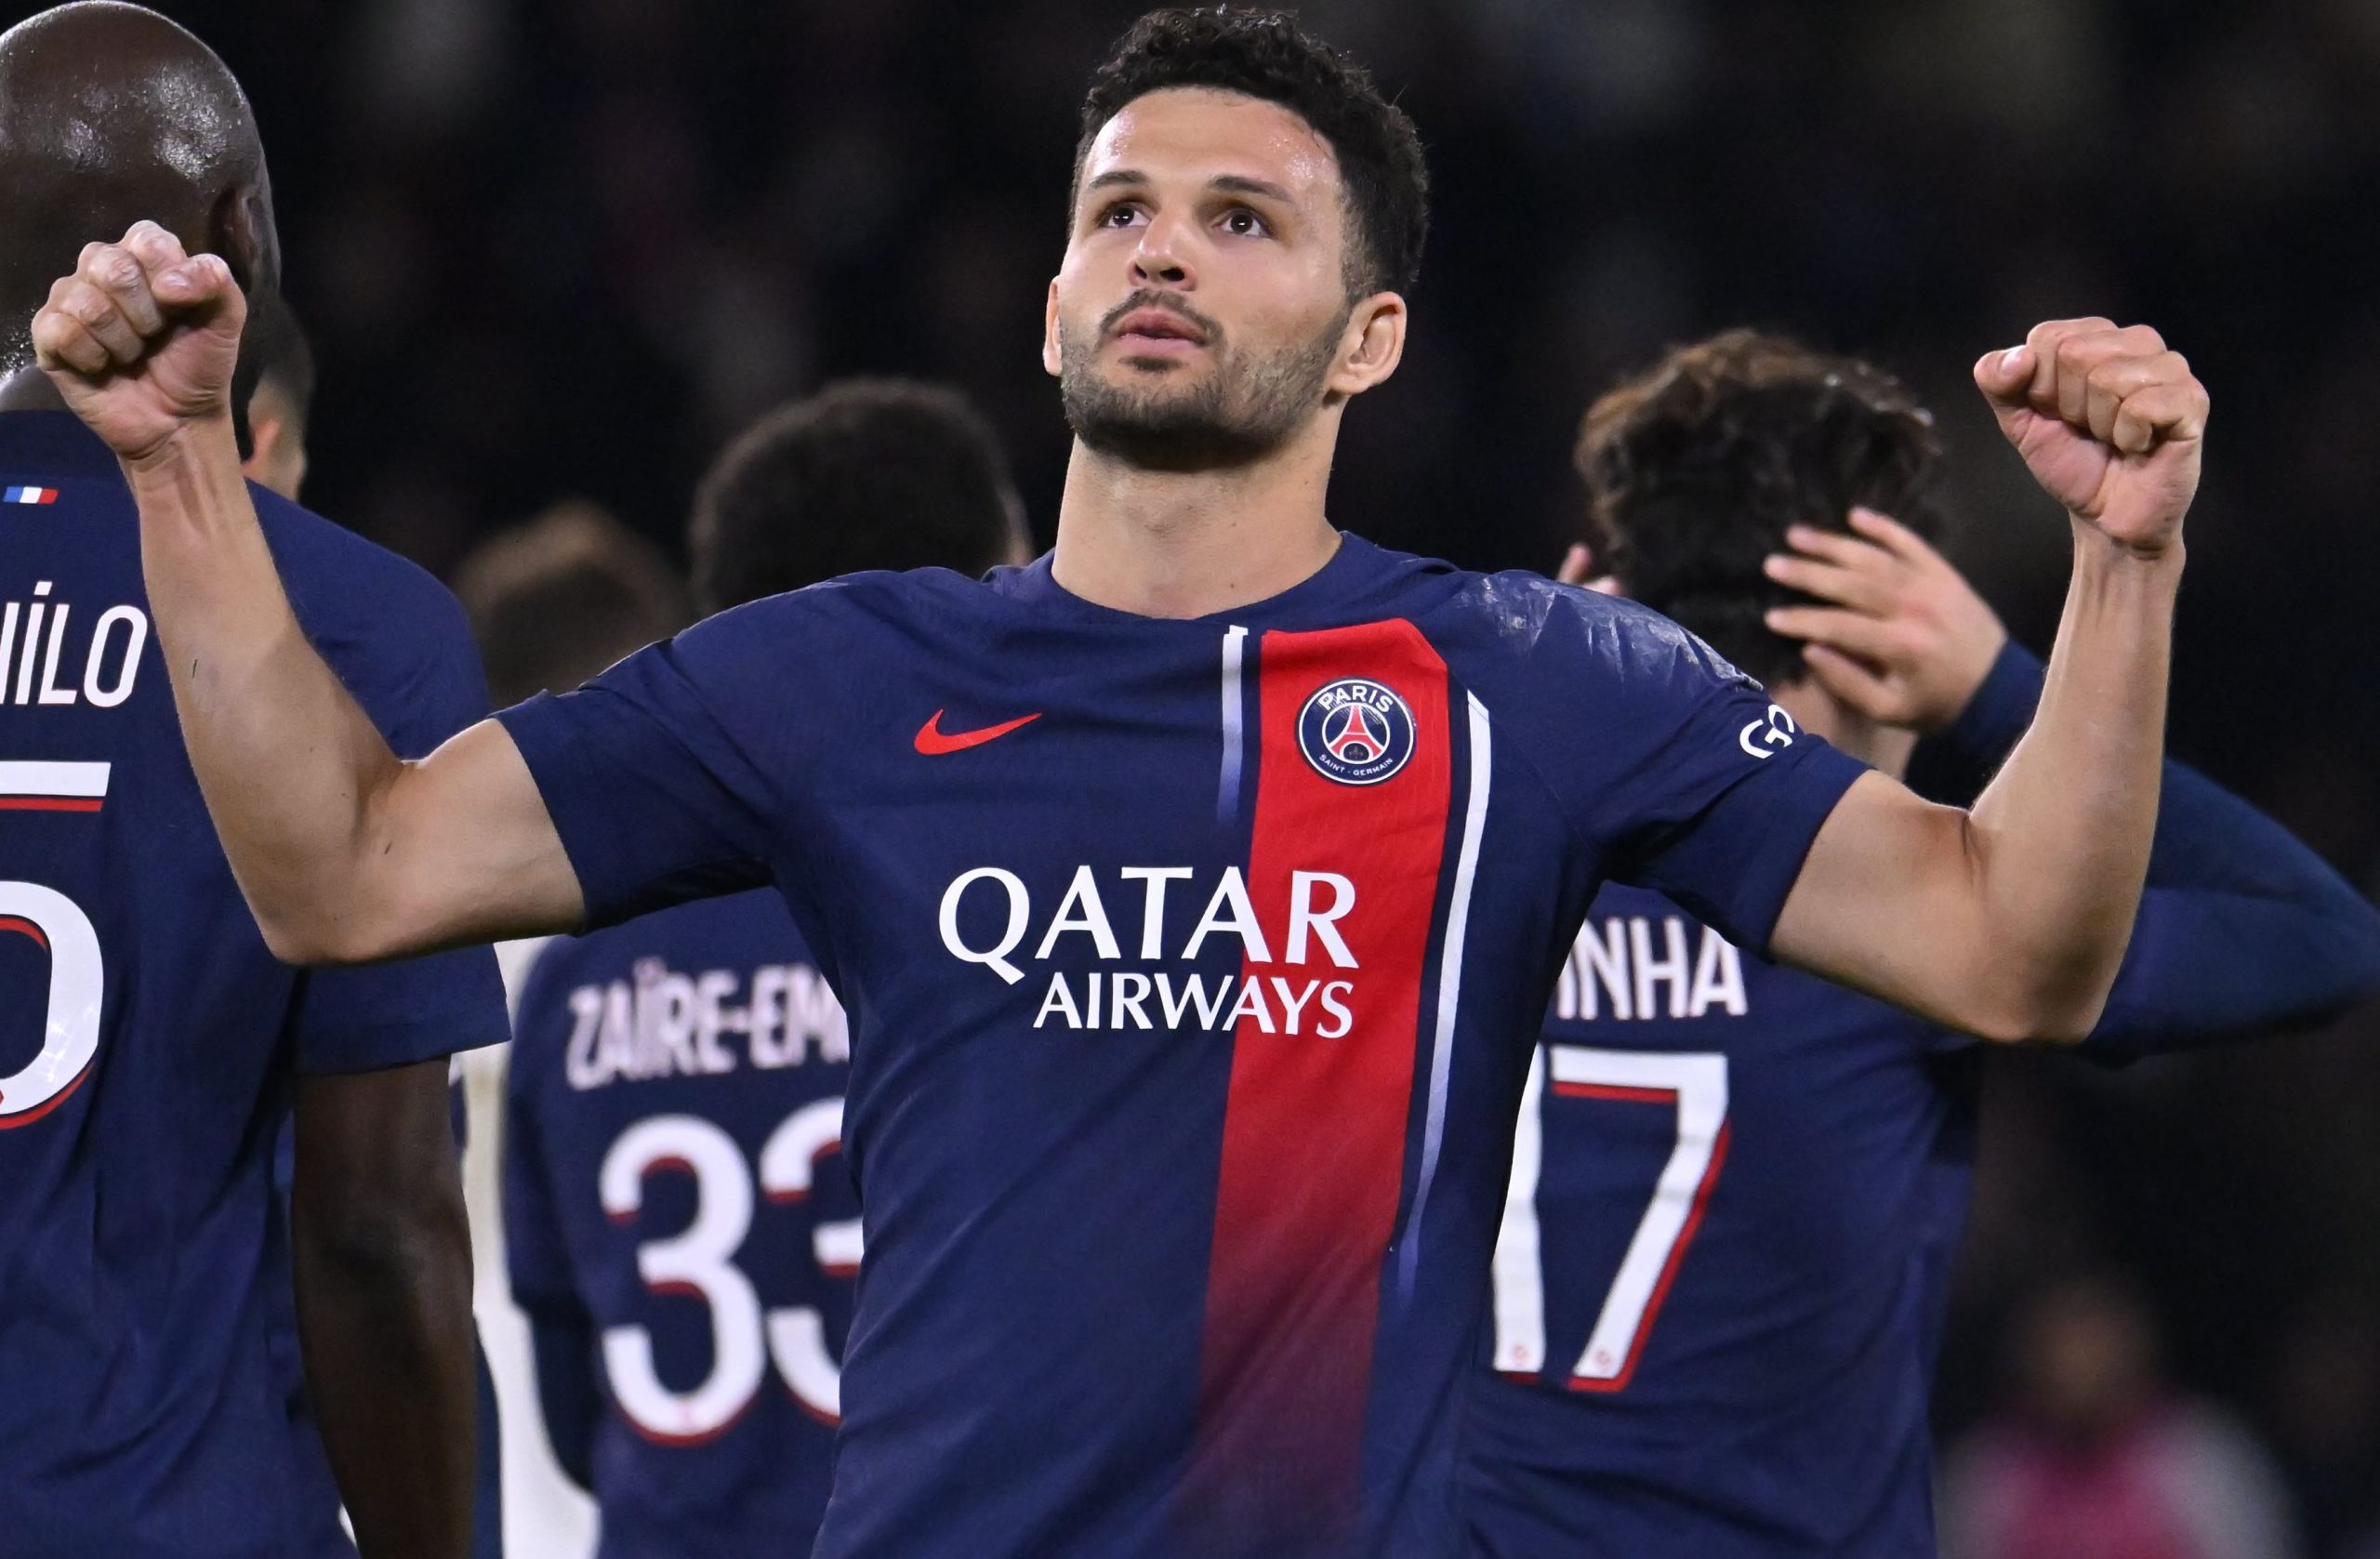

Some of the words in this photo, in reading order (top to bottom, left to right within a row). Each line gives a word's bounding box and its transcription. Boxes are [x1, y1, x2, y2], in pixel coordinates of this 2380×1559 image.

[1316, 685, 1394, 713] PARIS
[1318, 753, 1346, 773] SAINT
[1352, 757, 1394, 777] GERMAIN
[938, 865, 1359, 986] QATAR
[1032, 971, 1355, 1039] AIRWAYS
[1490, 1040, 1731, 1394] 17
[598, 1096, 864, 1447] 33
